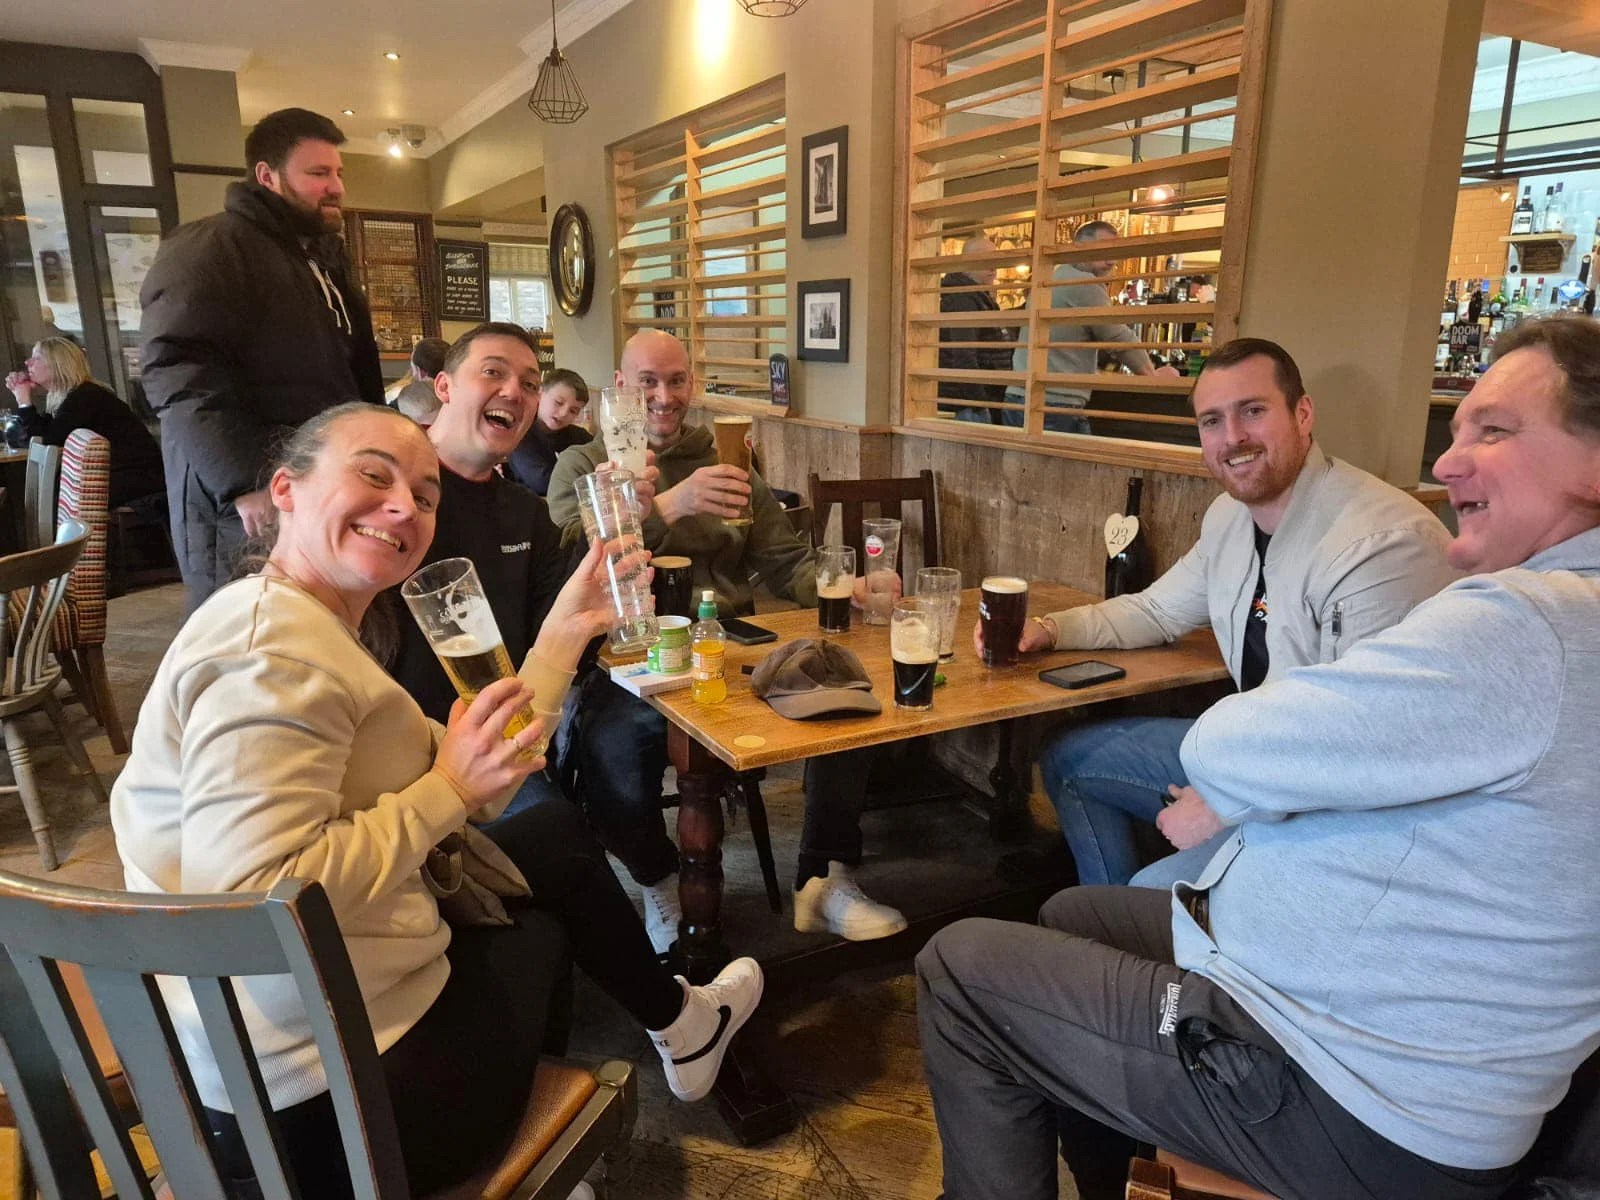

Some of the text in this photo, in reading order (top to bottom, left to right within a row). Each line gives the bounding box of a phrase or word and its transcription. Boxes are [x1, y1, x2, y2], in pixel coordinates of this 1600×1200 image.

[447, 275, 478, 285] PLEASE
[1452, 325, 1479, 336] DOOM
[1451, 335, 1468, 344] BAR
[1109, 527, 1129, 545] 23
